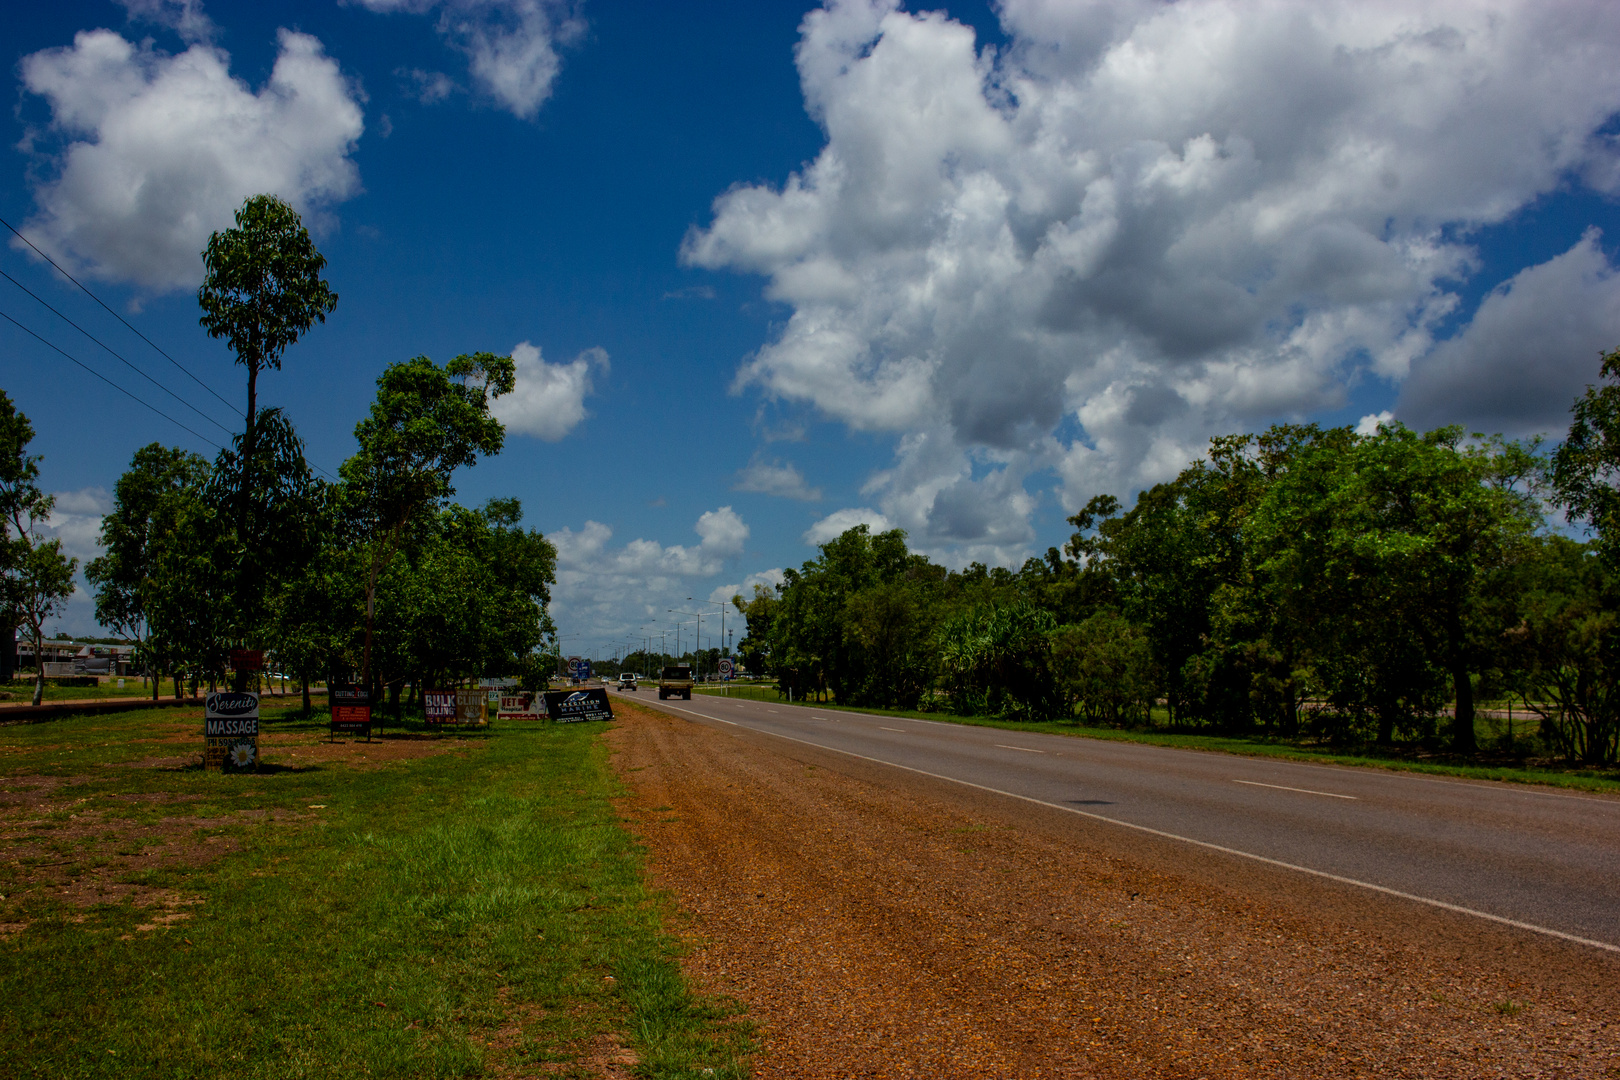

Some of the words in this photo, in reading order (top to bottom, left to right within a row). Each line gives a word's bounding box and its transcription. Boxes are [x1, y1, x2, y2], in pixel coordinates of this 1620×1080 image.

[210, 693, 256, 713] Serenity
[424, 694, 456, 707] BULK
[457, 696, 487, 706] CLINIC
[502, 698, 516, 706] VET
[558, 699, 600, 708] PRECISION
[561, 704, 599, 712] MARINE
[208, 720, 257, 734] MASSAGE
